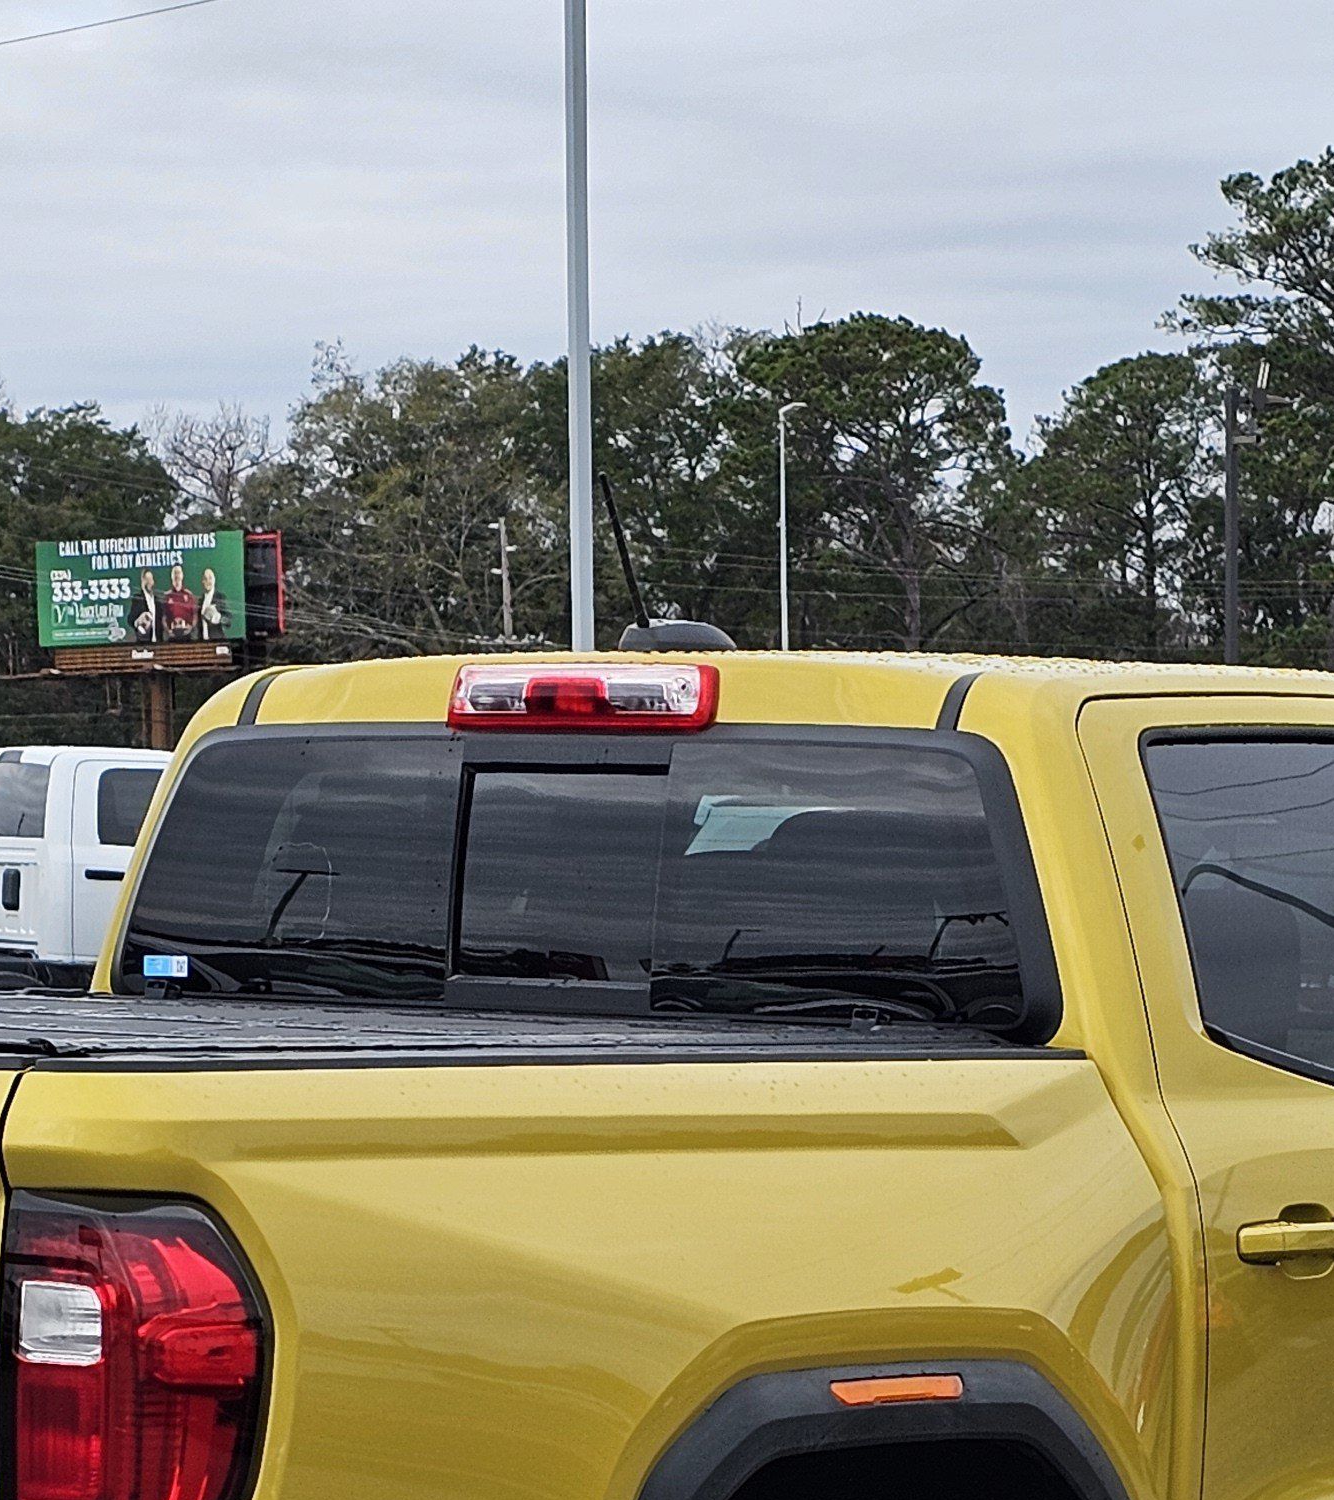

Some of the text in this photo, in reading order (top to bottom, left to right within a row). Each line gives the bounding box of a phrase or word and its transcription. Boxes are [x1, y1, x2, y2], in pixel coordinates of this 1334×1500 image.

[59, 532, 216, 557] CALL THE OFFICIAL INJURY LAWYERS
[92, 551, 183, 571] FOR TROY ATHLETICS
[51, 578, 131, 602] 333-3333
